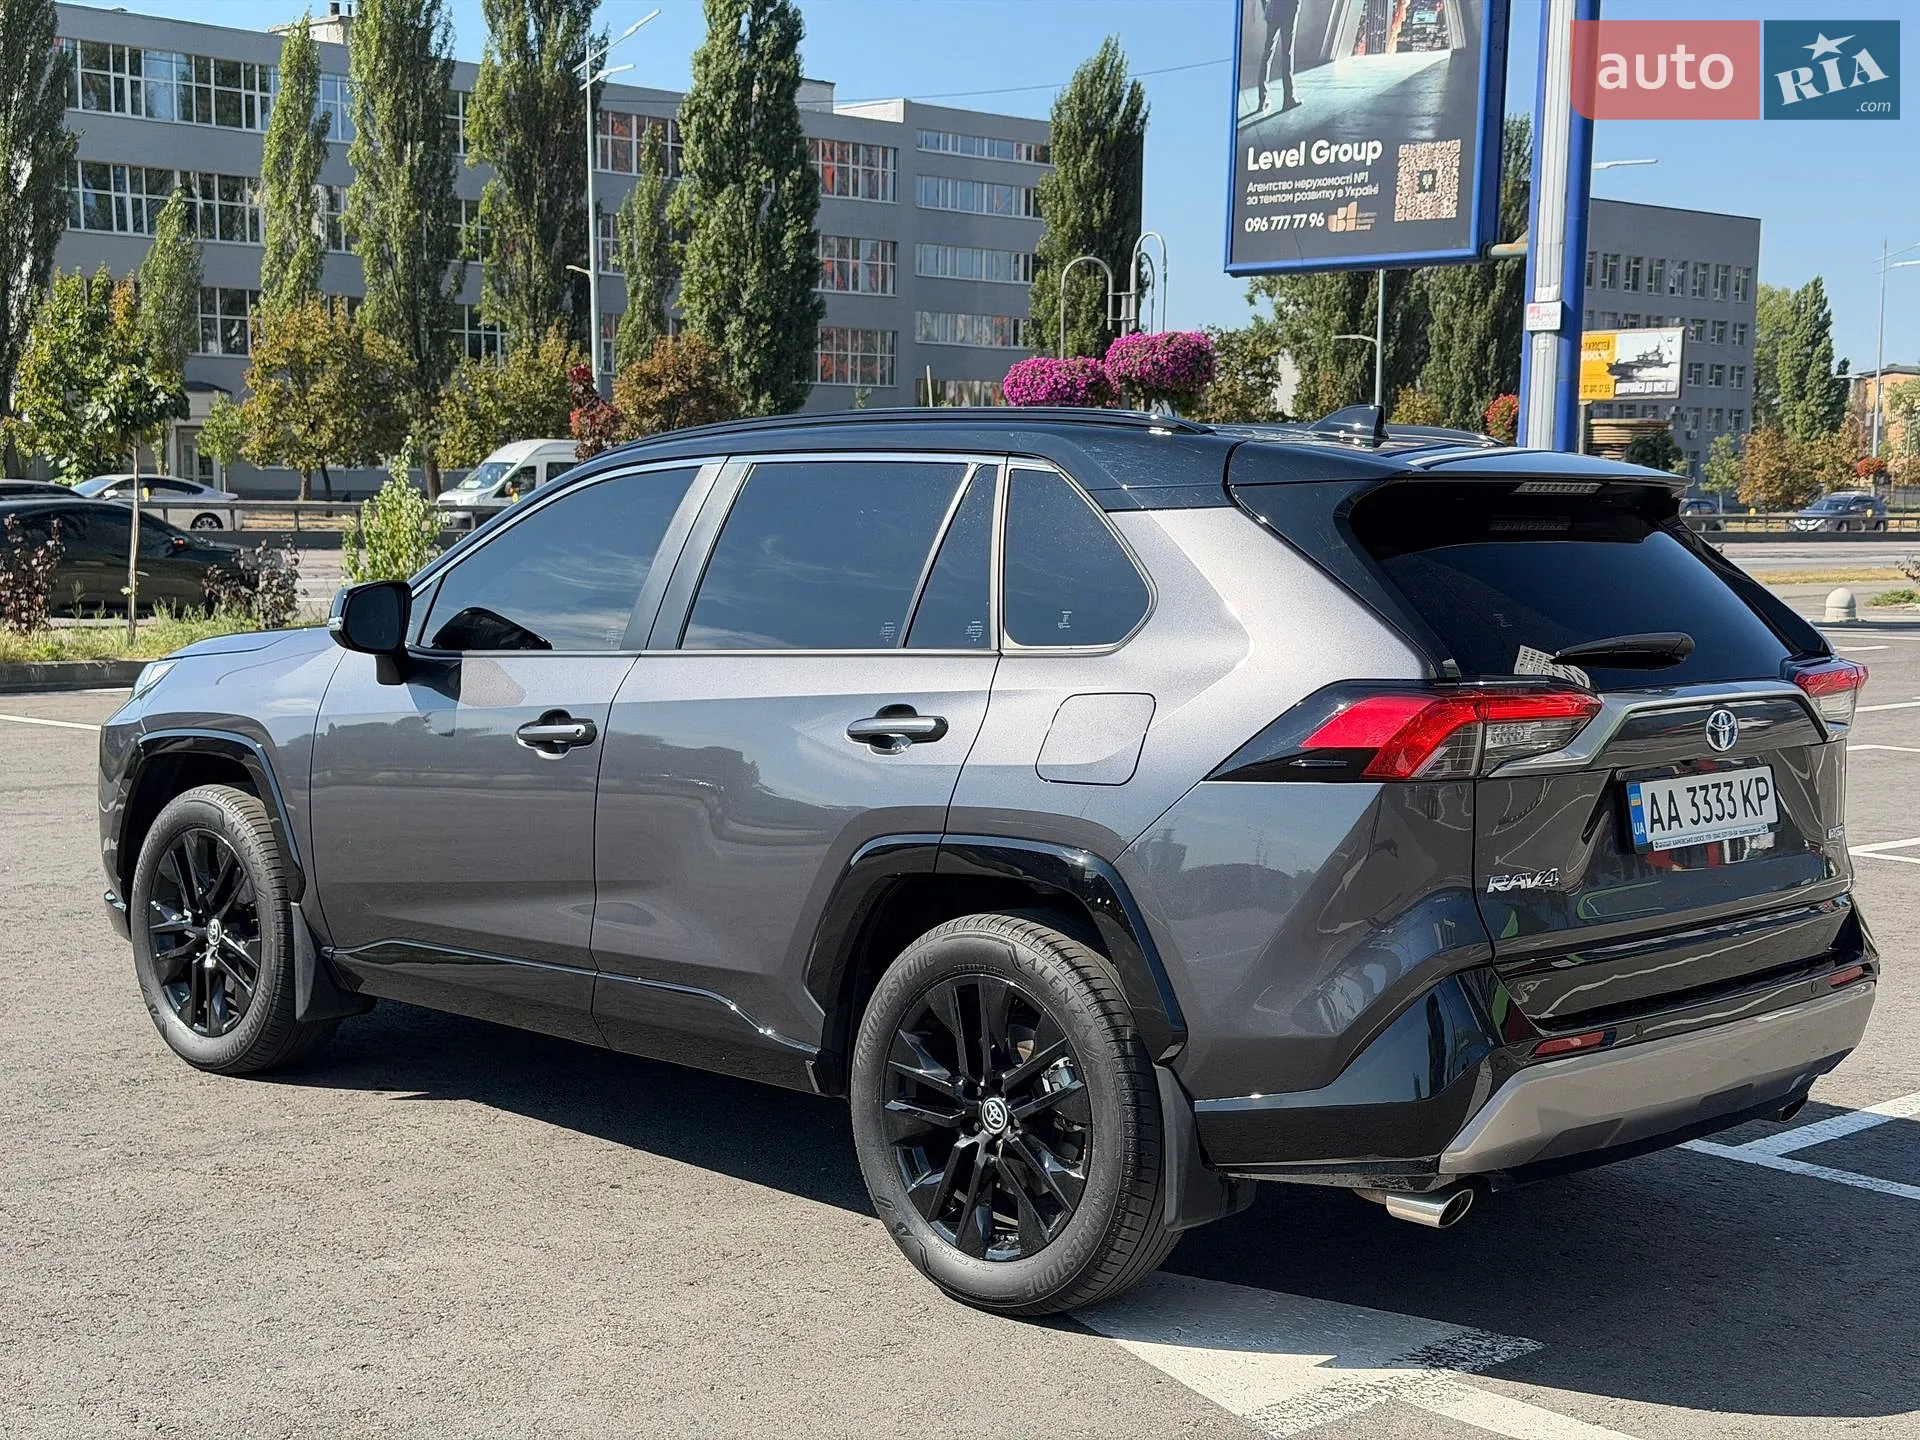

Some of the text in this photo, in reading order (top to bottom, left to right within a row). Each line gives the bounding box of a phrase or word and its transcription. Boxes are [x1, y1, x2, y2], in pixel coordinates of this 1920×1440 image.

[1247, 138, 1383, 171] Level Group
[1246, 171, 1369, 193] Агентство нерухомості №1
[1246, 182, 1380, 206] за темпом розвитку в Україні
[1245, 212, 1325, 233] 096 777 77 96
[1650, 776, 1770, 833] AA 3333 KP
[1634, 822, 1645, 835] UA
[1486, 867, 1559, 894] RAV4
[1025, 957, 1094, 1039] ALENZA
